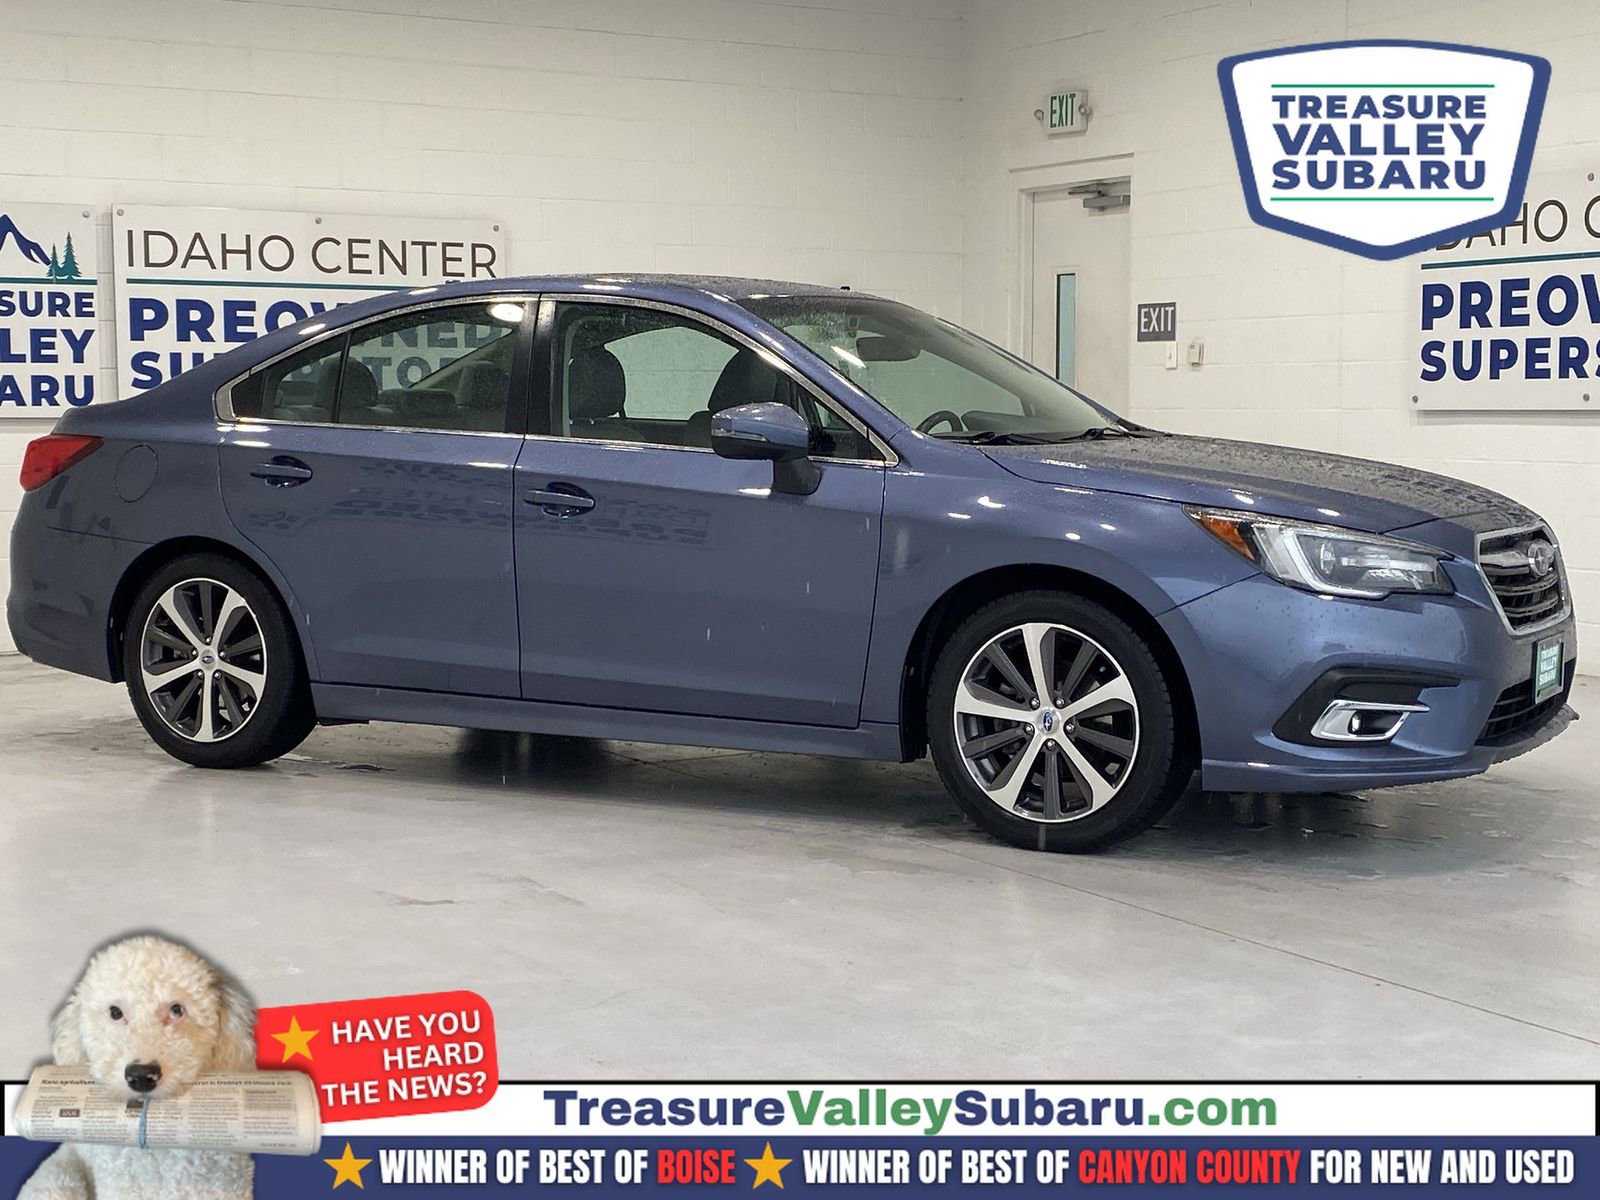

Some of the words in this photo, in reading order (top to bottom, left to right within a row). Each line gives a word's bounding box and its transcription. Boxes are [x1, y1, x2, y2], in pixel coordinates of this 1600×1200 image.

[1049, 93, 1077, 128] EXIT
[127, 230, 295, 272] IDAHO
[311, 237, 497, 278] CENTER
[1140, 307, 1175, 333] EXIT
[1420, 336, 1600, 382] SUPER
